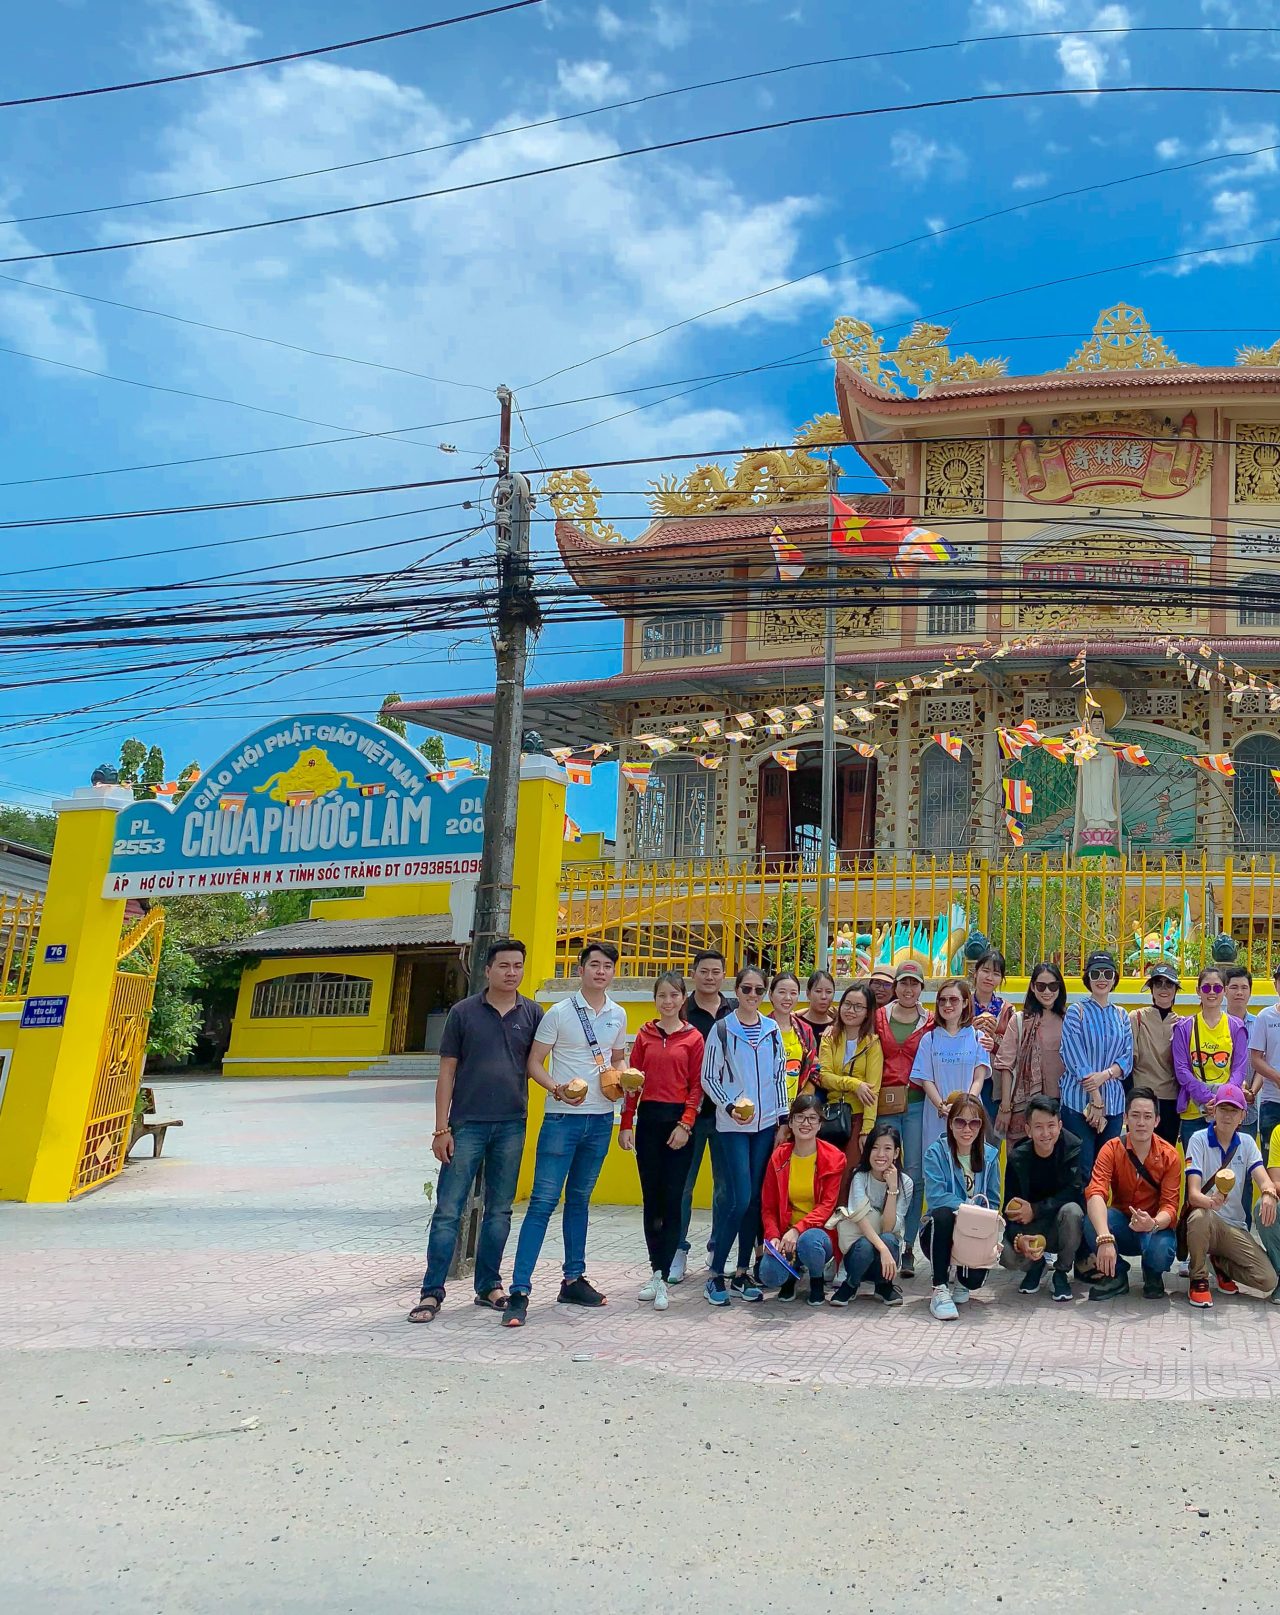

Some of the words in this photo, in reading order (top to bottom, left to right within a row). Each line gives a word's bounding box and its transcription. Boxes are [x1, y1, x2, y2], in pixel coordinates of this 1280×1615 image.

[387, 757, 424, 797] NAM
[130, 819, 156, 836] PL
[361, 789, 432, 848] LÂM
[446, 816, 484, 835] 200
[113, 837, 166, 856] 2553
[113, 873, 130, 892] ẤP
[177, 875, 185, 888] T
[188, 874, 197, 887] T
[209, 868, 249, 887] XUYÊN
[252, 871, 261, 884] H
[275, 869, 284, 884] X
[289, 863, 316, 882] TỈNH
[317, 863, 340, 881] SÓC
[344, 861, 381, 880] TRĂNG
[385, 862, 400, 878] ĐT
[50, 946, 63, 956] 76
